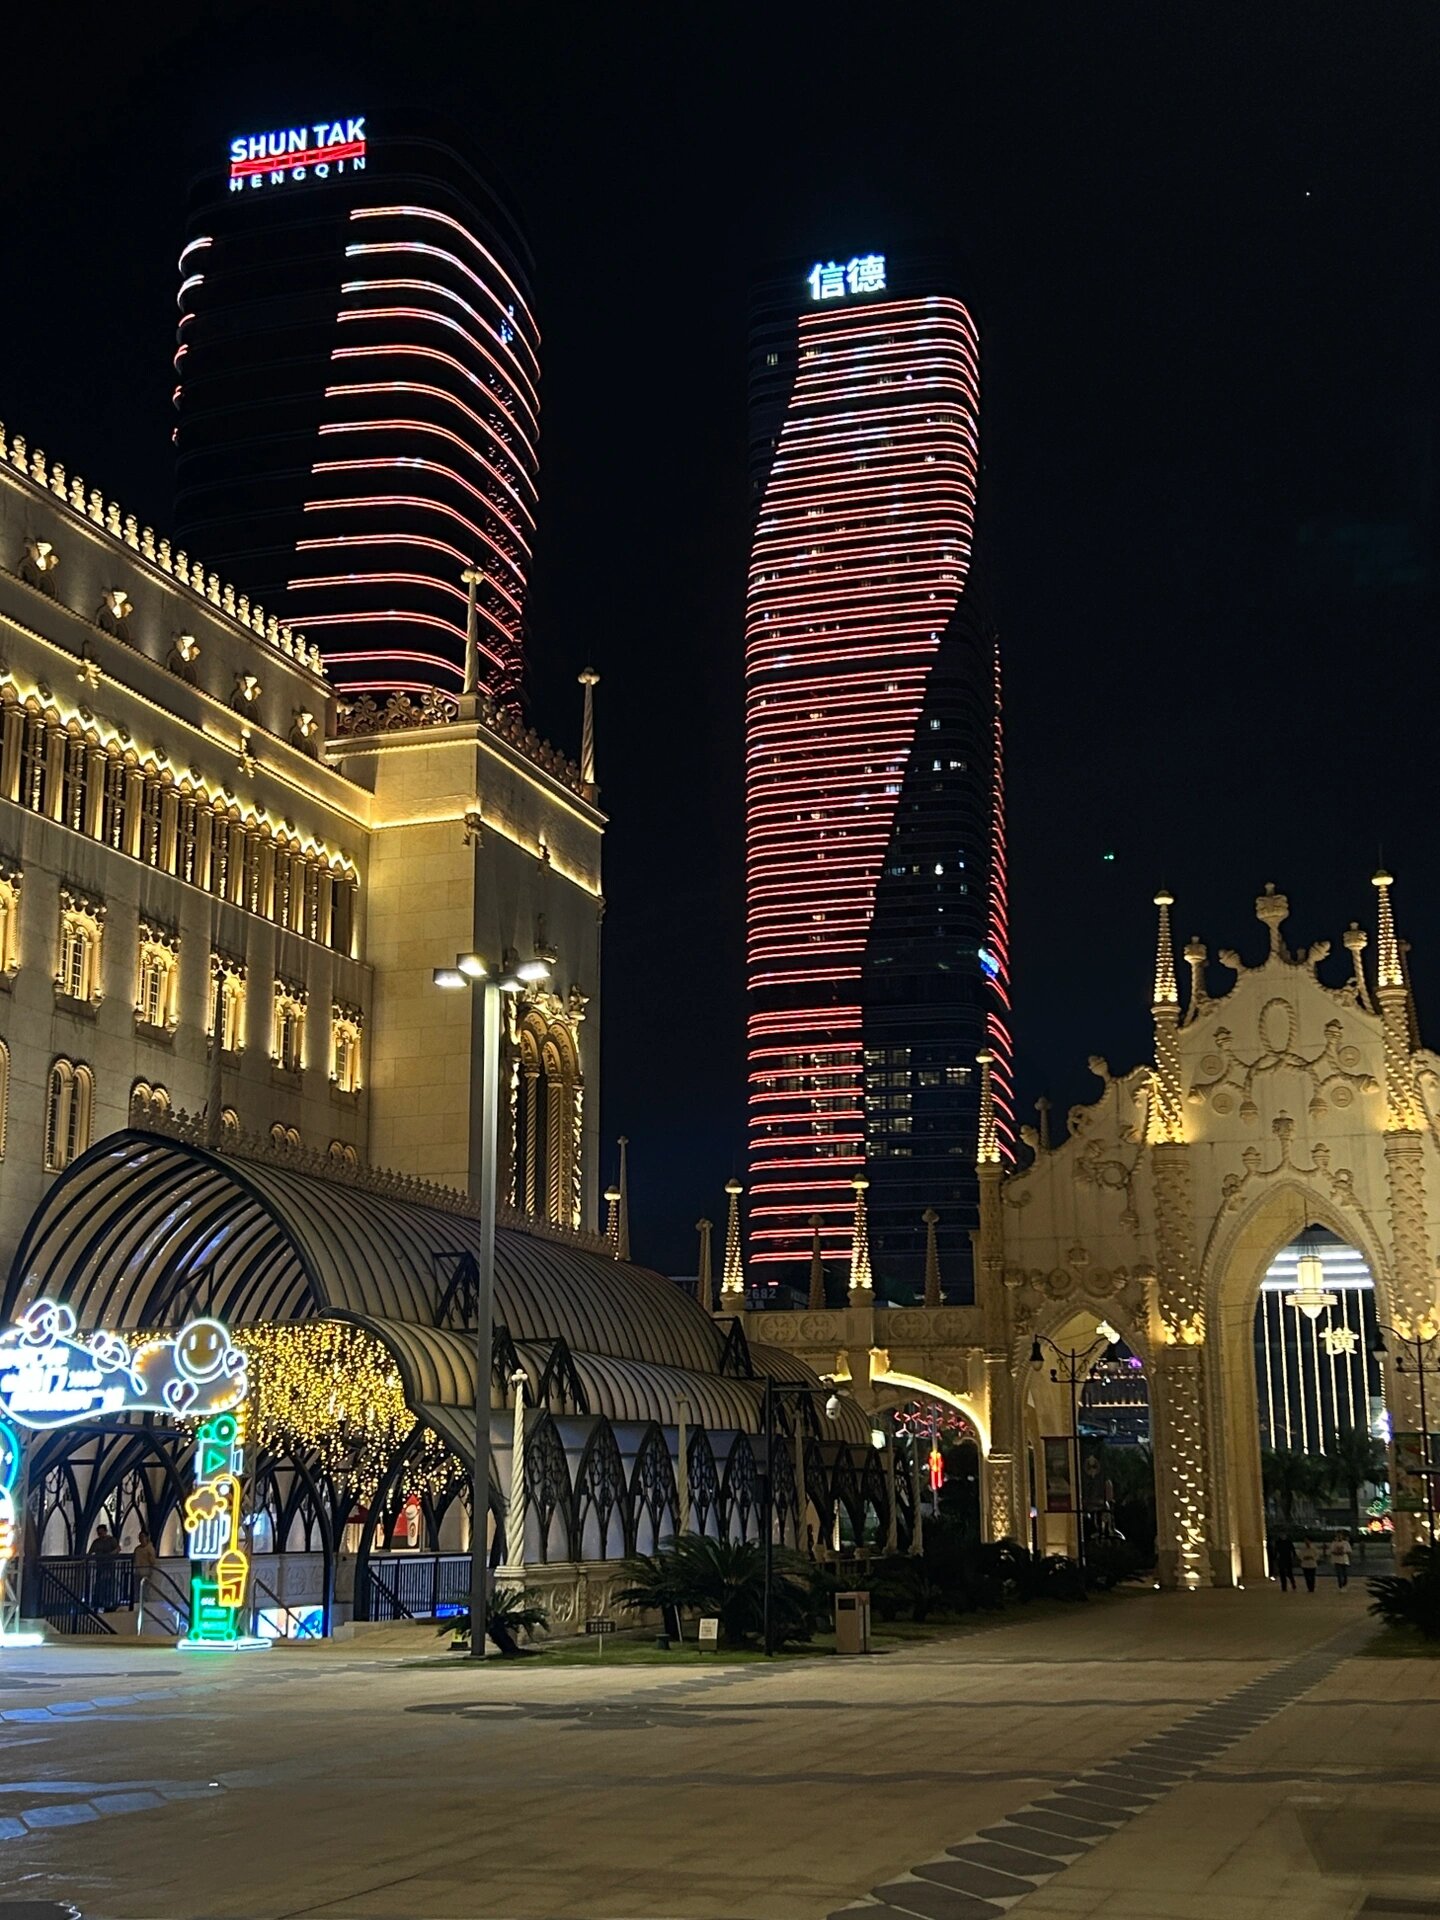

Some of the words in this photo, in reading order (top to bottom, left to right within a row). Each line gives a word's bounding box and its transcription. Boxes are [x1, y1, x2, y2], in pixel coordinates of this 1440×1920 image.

[229, 128, 308, 163] SHUN
[312, 117, 366, 149] TAK
[229, 157, 366, 192] HENGQIN
[807, 254, 887, 300] 信德
